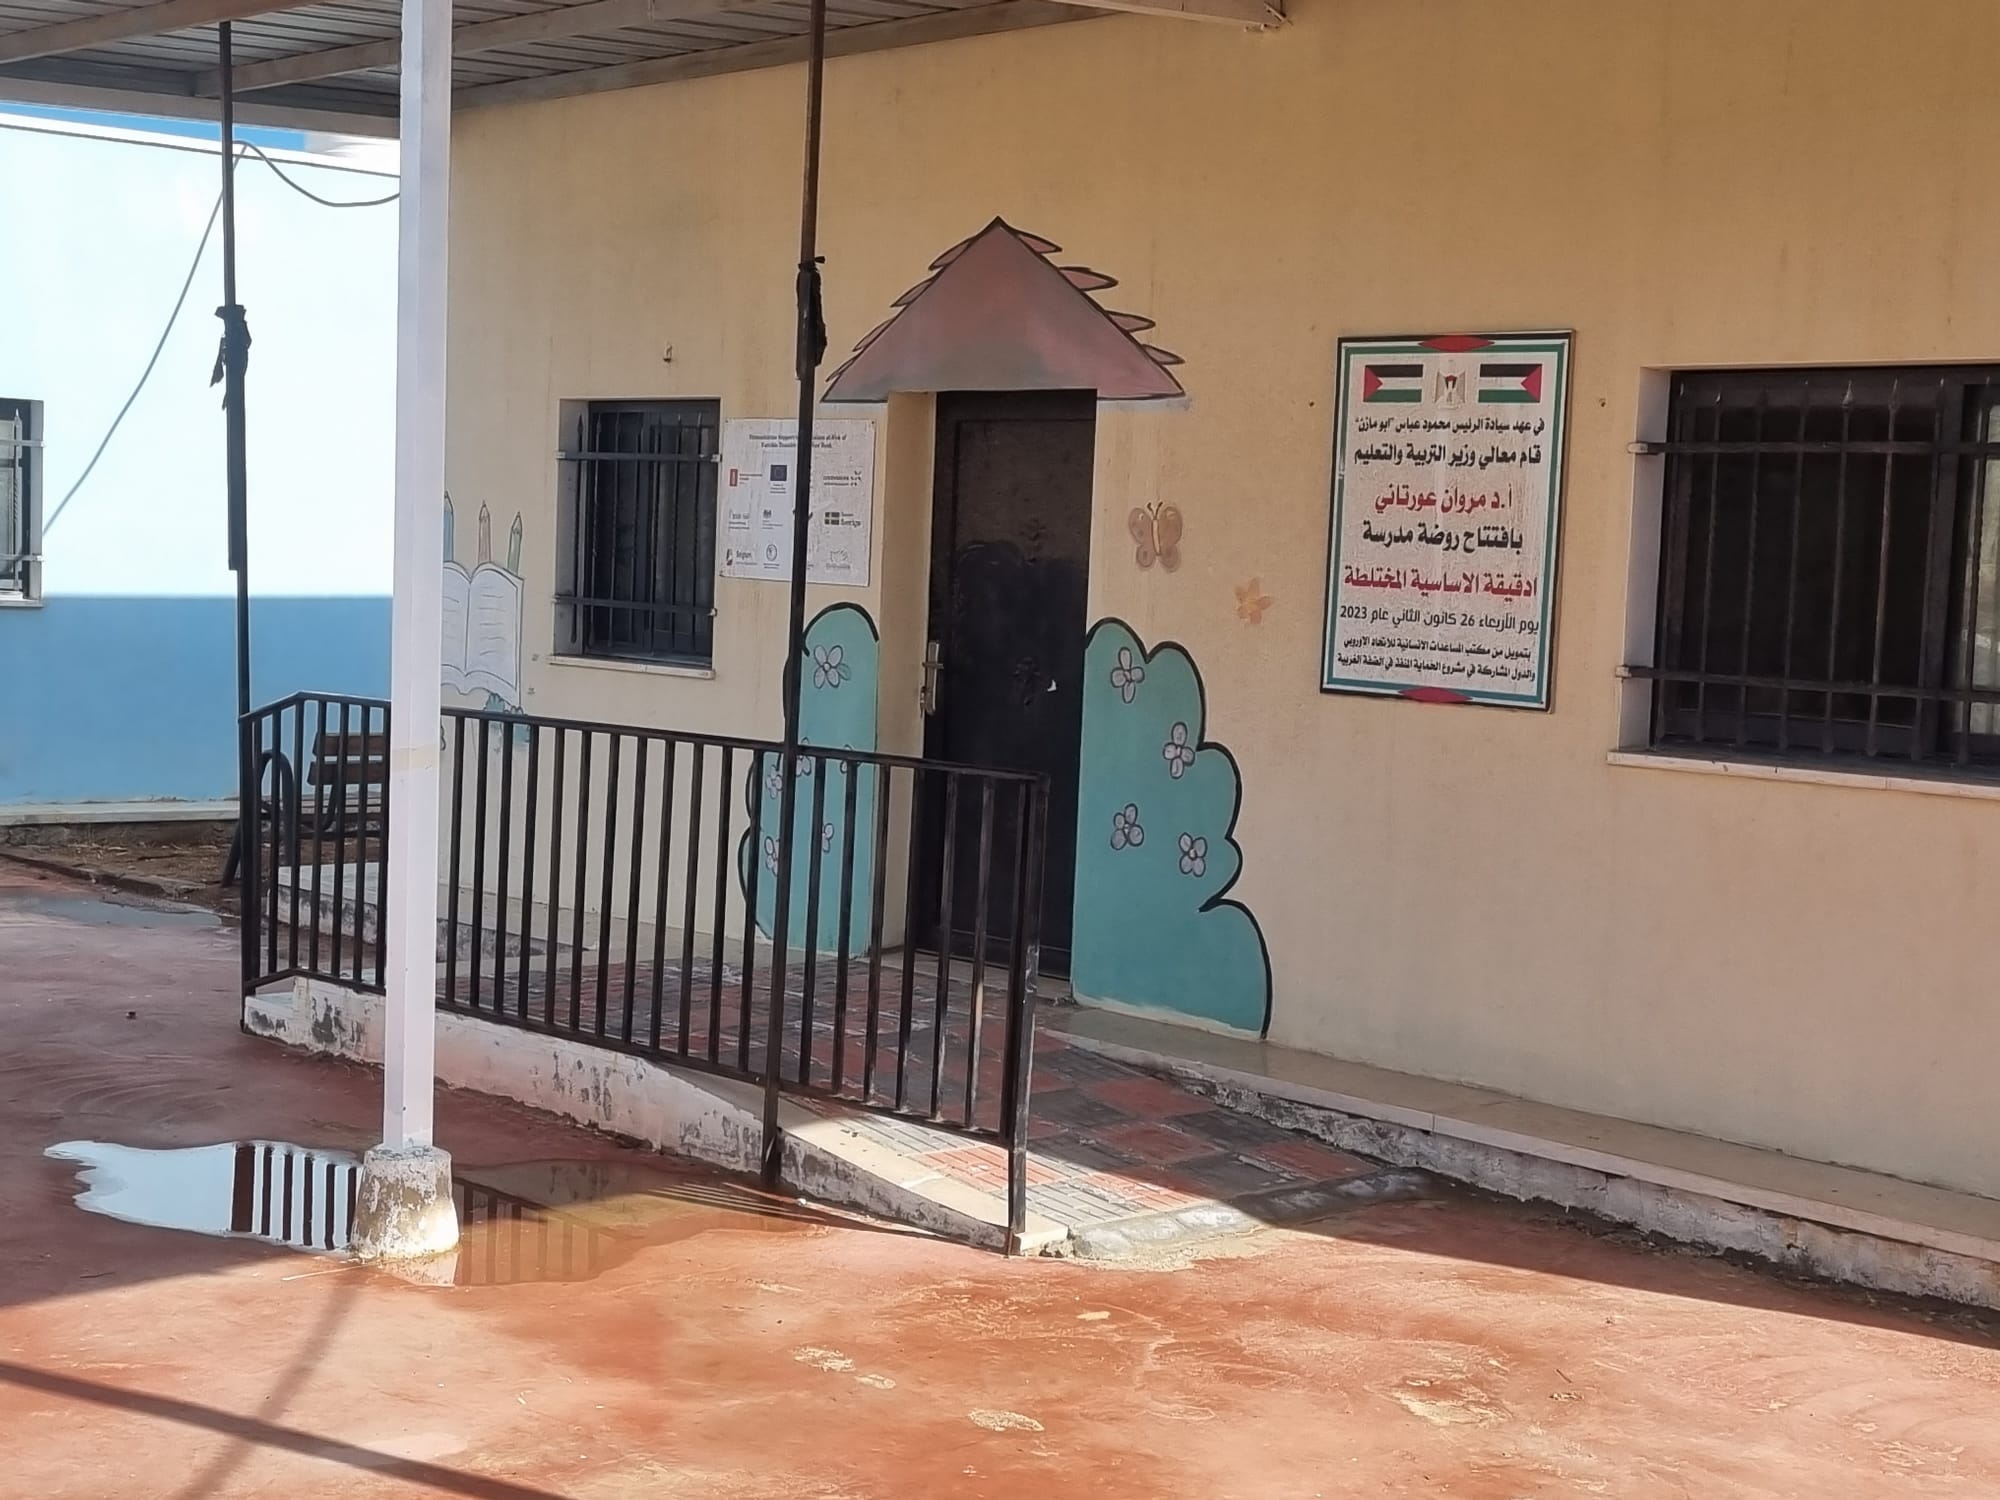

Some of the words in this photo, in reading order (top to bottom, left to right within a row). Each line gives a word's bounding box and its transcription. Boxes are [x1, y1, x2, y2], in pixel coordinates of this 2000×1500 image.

[1395, 418, 1421, 433] عباس
[1422, 419, 1450, 433] محمود
[1485, 417, 1510, 433] سيادة
[1512, 421, 1531, 434] عهد
[1533, 417, 1545, 436] في
[1354, 443, 1403, 465] والتعليم
[1406, 443, 1446, 466] التربية
[1449, 443, 1476, 466] وزير
[1478, 445, 1516, 470] معالي
[1519, 444, 1542, 468] قام
[1375, 483, 1437, 513] عورتاني
[1441, 485, 1486, 514] مروان
[1362, 520, 1413, 548] مدرسة
[1418, 522, 1459, 551] روضة
[1463, 525, 1523, 555] بافتتاح
[1344, 565, 1407, 589] المختلطة
[1411, 568, 1480, 597] الاساسية
[1484, 572, 1537, 602] ادقيقة
[1340, 605, 1367, 619] 2023
[1370, 608, 1389, 624] عام
[1392, 608, 1420, 628] الثاني
[1423, 611, 1457, 628] كانون
[1460, 613, 1475, 627] 26
[1518, 620, 1539, 634] يوم
[1491, 648, 1503, 659] من
[1467, 663, 1476, 678] في
